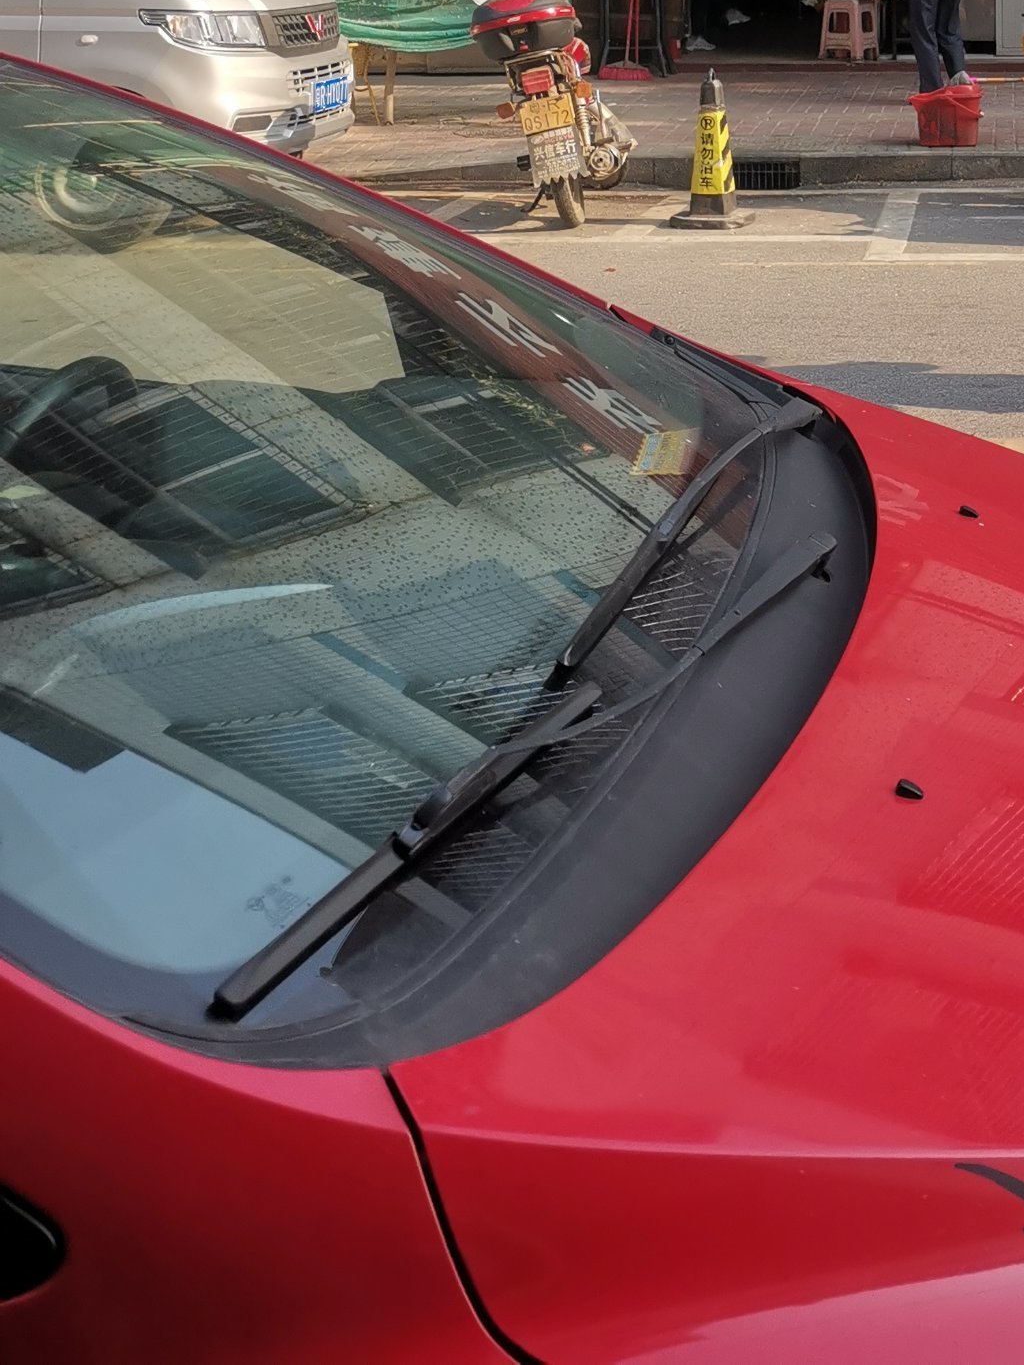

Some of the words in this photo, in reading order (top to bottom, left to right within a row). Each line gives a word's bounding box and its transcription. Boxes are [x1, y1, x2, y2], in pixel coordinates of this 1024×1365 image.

[524, 109, 571, 132] QS172
[533, 139, 576, 161] 兴信车行
[700, 132, 717, 190] 请勿泊车
